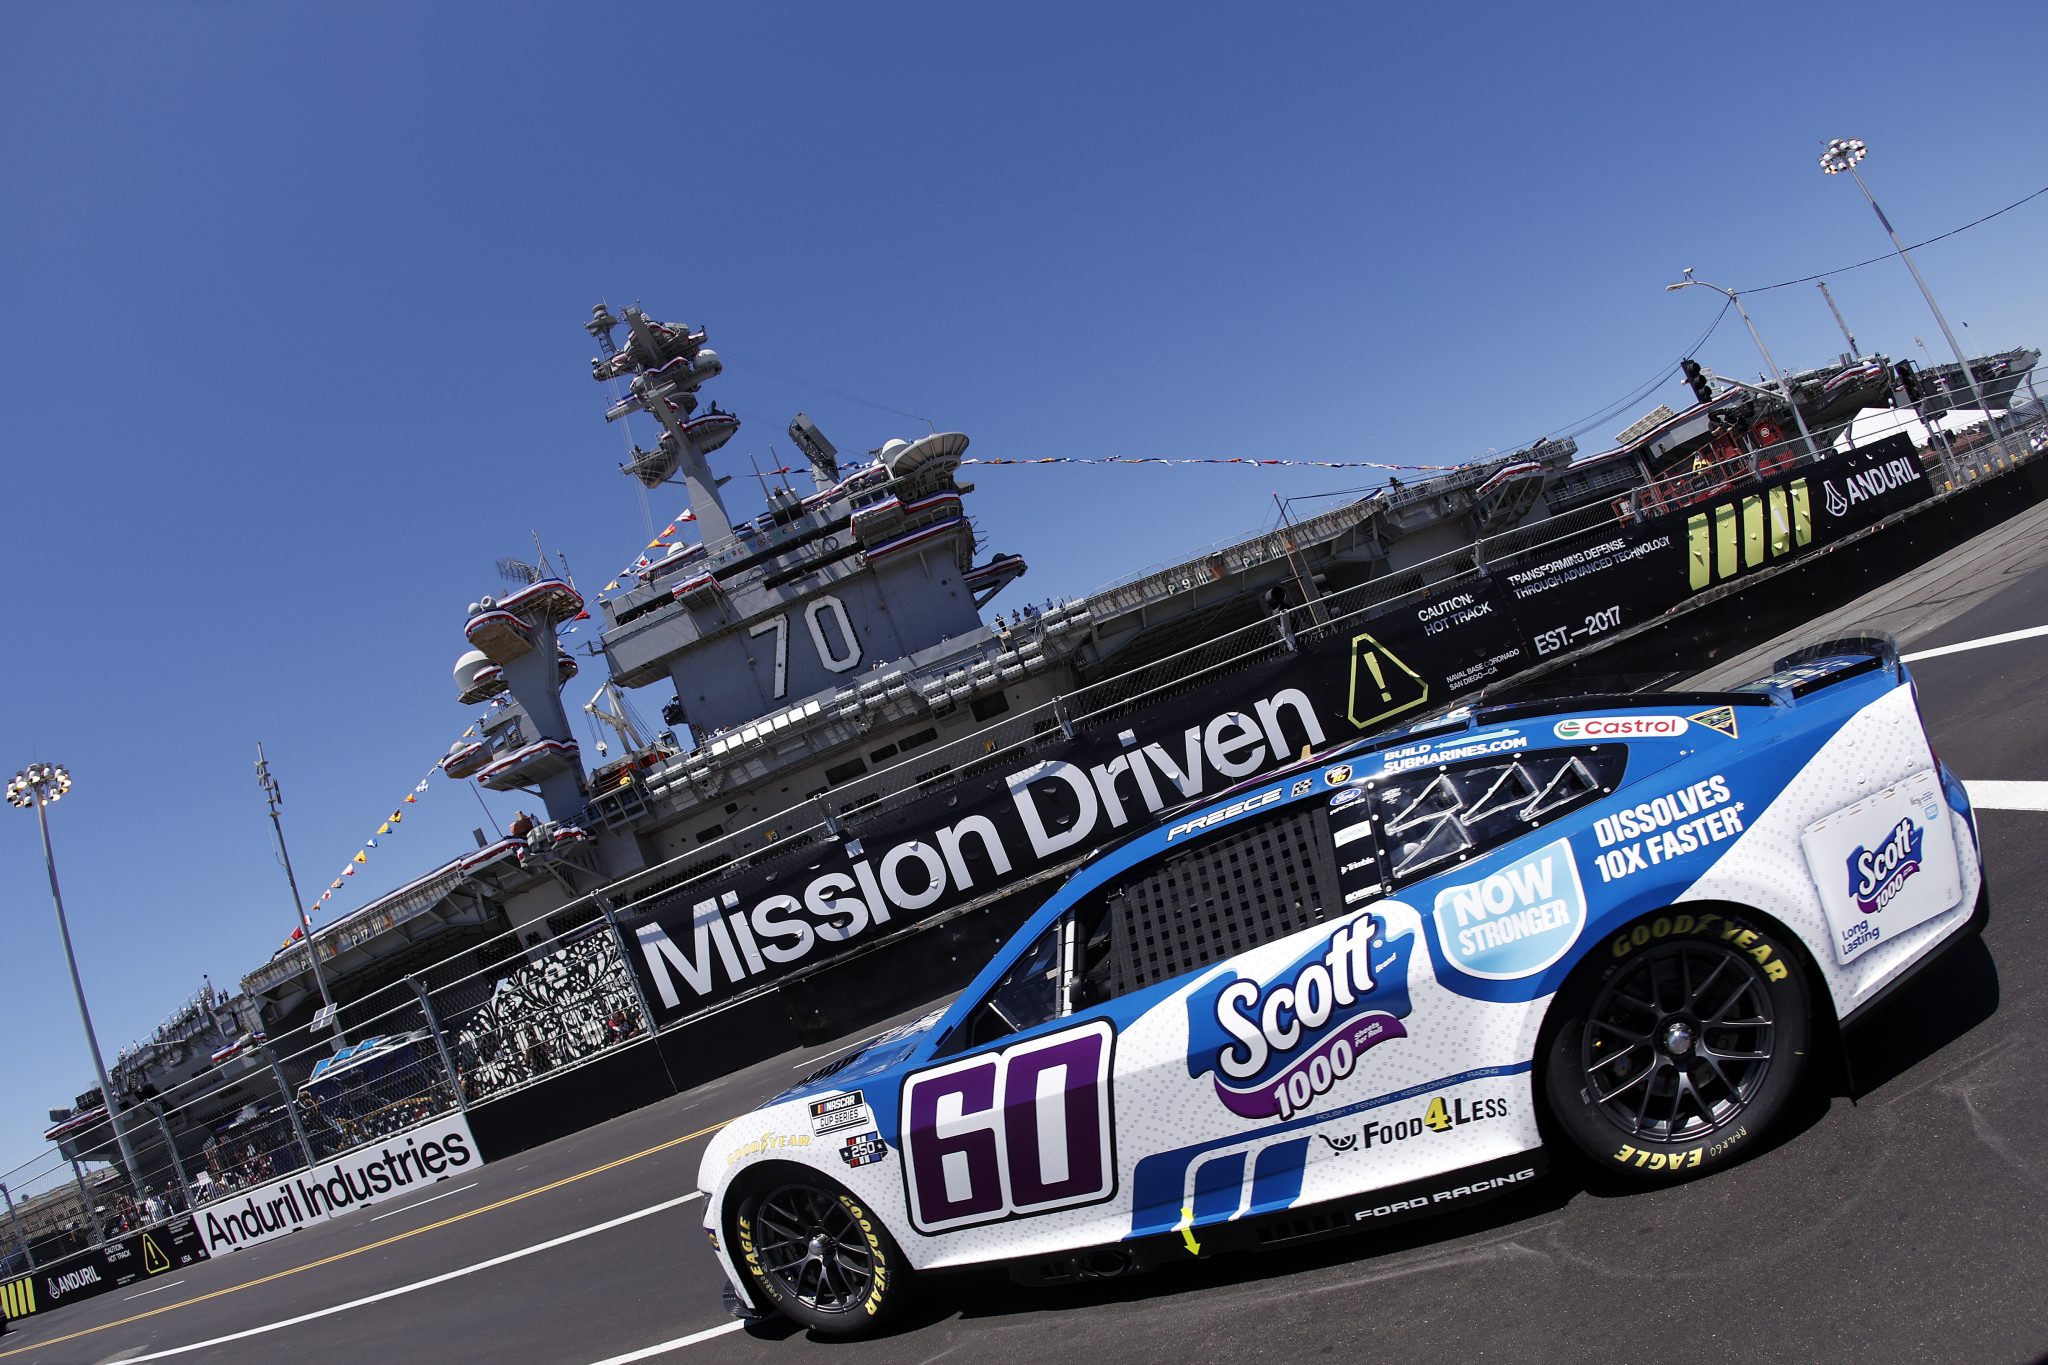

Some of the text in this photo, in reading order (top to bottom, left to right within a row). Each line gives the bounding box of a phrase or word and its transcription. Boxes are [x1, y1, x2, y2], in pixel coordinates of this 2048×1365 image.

[1846, 456, 1920, 505] ANDURIL
[1507, 538, 1626, 587] TRANSFORMING DEFENSE
[1513, 536, 1671, 600] THROUGH ADVANCED TECHNOLOGY
[1418, 593, 1475, 622] CAUTION:
[1424, 601, 1493, 636] HOT TRACK
[749, 595, 864, 700] 70
[1446, 648, 1520, 684] NAVAL BASE CORONADO
[1449, 679, 1464, 692] SAN
[1584, 719, 1676, 736] Castrol
[1383, 736, 1528, 773] SUBMARINES.COM
[1384, 744, 1432, 761] BUILD
[1166, 788, 1282, 842] PREECE
[1593, 775, 1731, 848] DISSOLVES
[635, 687, 1327, 1009] Mission Driven
[1595, 842, 1650, 882] 10X
[1857, 817, 1912, 896] Scott
[1452, 856, 1552, 927] NOW
[1876, 873, 1904, 913] 1000
[1458, 899, 1571, 956] STRONGER
[1611, 913, 1789, 983] GOODYEAR
[1841, 919, 1868, 941] Long
[1843, 926, 1880, 956] Lasting
[1215, 913, 1377, 1079] Scott
[827, 1095, 855, 1111] NASCAR
[1273, 1039, 1355, 1119] 1000
[1315, 1108, 1347, 1121] ROUSH
[1355, 1095, 1391, 1110] FENWAY
[1466, 1067, 1499, 1079] RACING
[820, 1109, 859, 1127] CUP SERIES
[901, 1019, 1114, 1234] 60
[850, 1141, 876, 1158] 250
[1613, 1144, 1703, 1170] EAGLE
[206, 1133, 471, 1251] Anduril Industries
[1355, 1168, 1535, 1221] FORD RACING
[739, 1216, 764, 1276] EAGLE
[838, 1195, 887, 1316] GOODYEAR
[58, 1266, 101, 1293] ANDURIL
